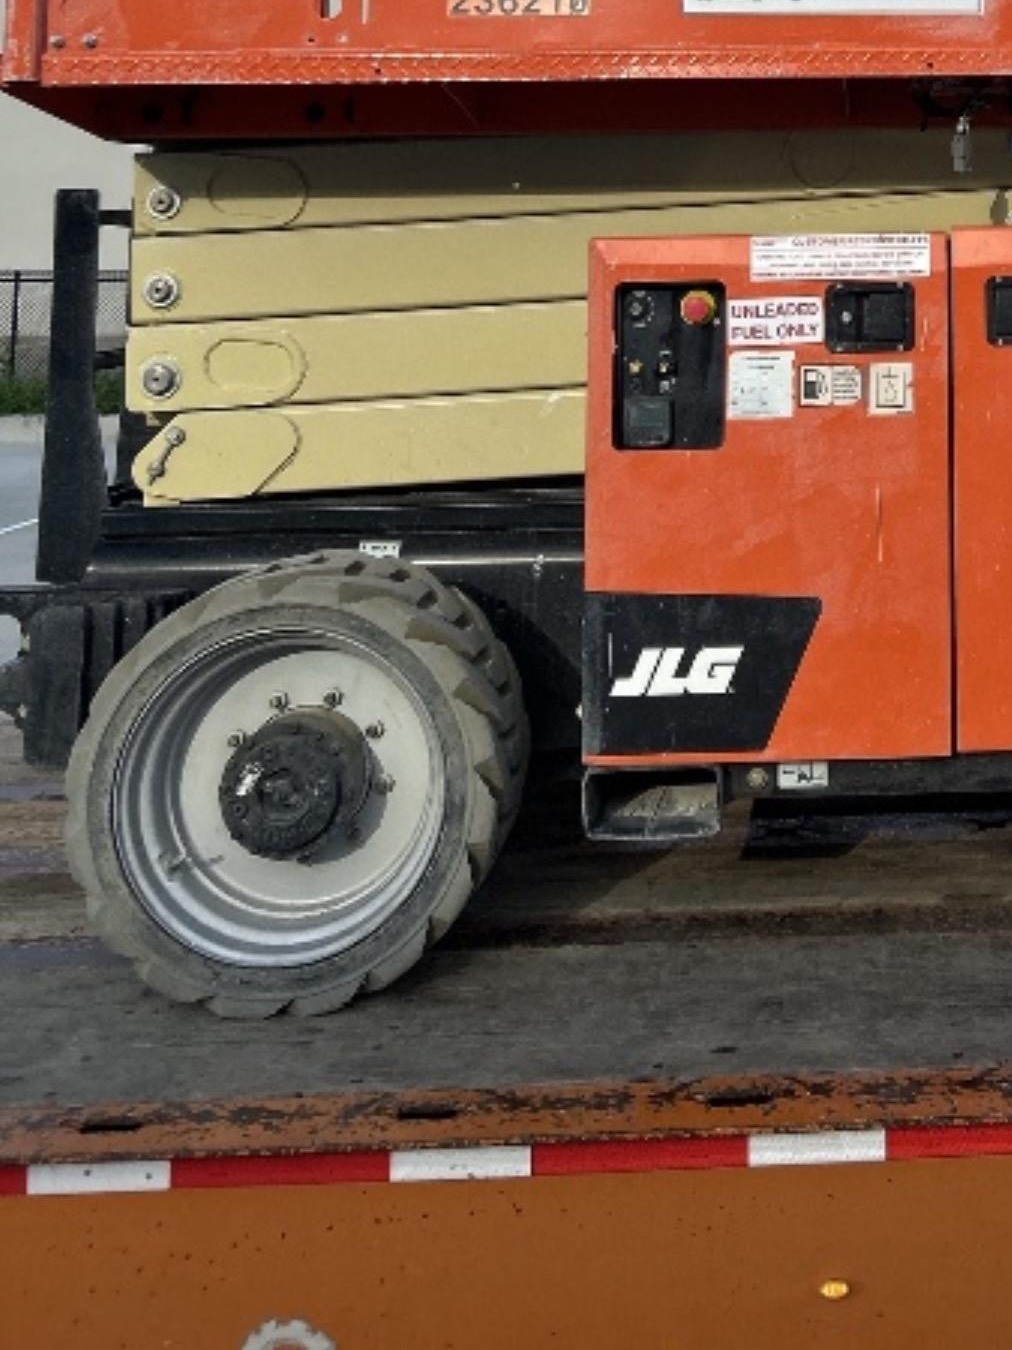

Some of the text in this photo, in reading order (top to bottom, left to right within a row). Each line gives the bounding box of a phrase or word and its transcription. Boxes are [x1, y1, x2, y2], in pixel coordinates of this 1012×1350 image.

[731, 302, 819, 319] UNLEADED
[731, 323, 819, 340] FUEL ONLY
[608, 645, 745, 697] JLG
